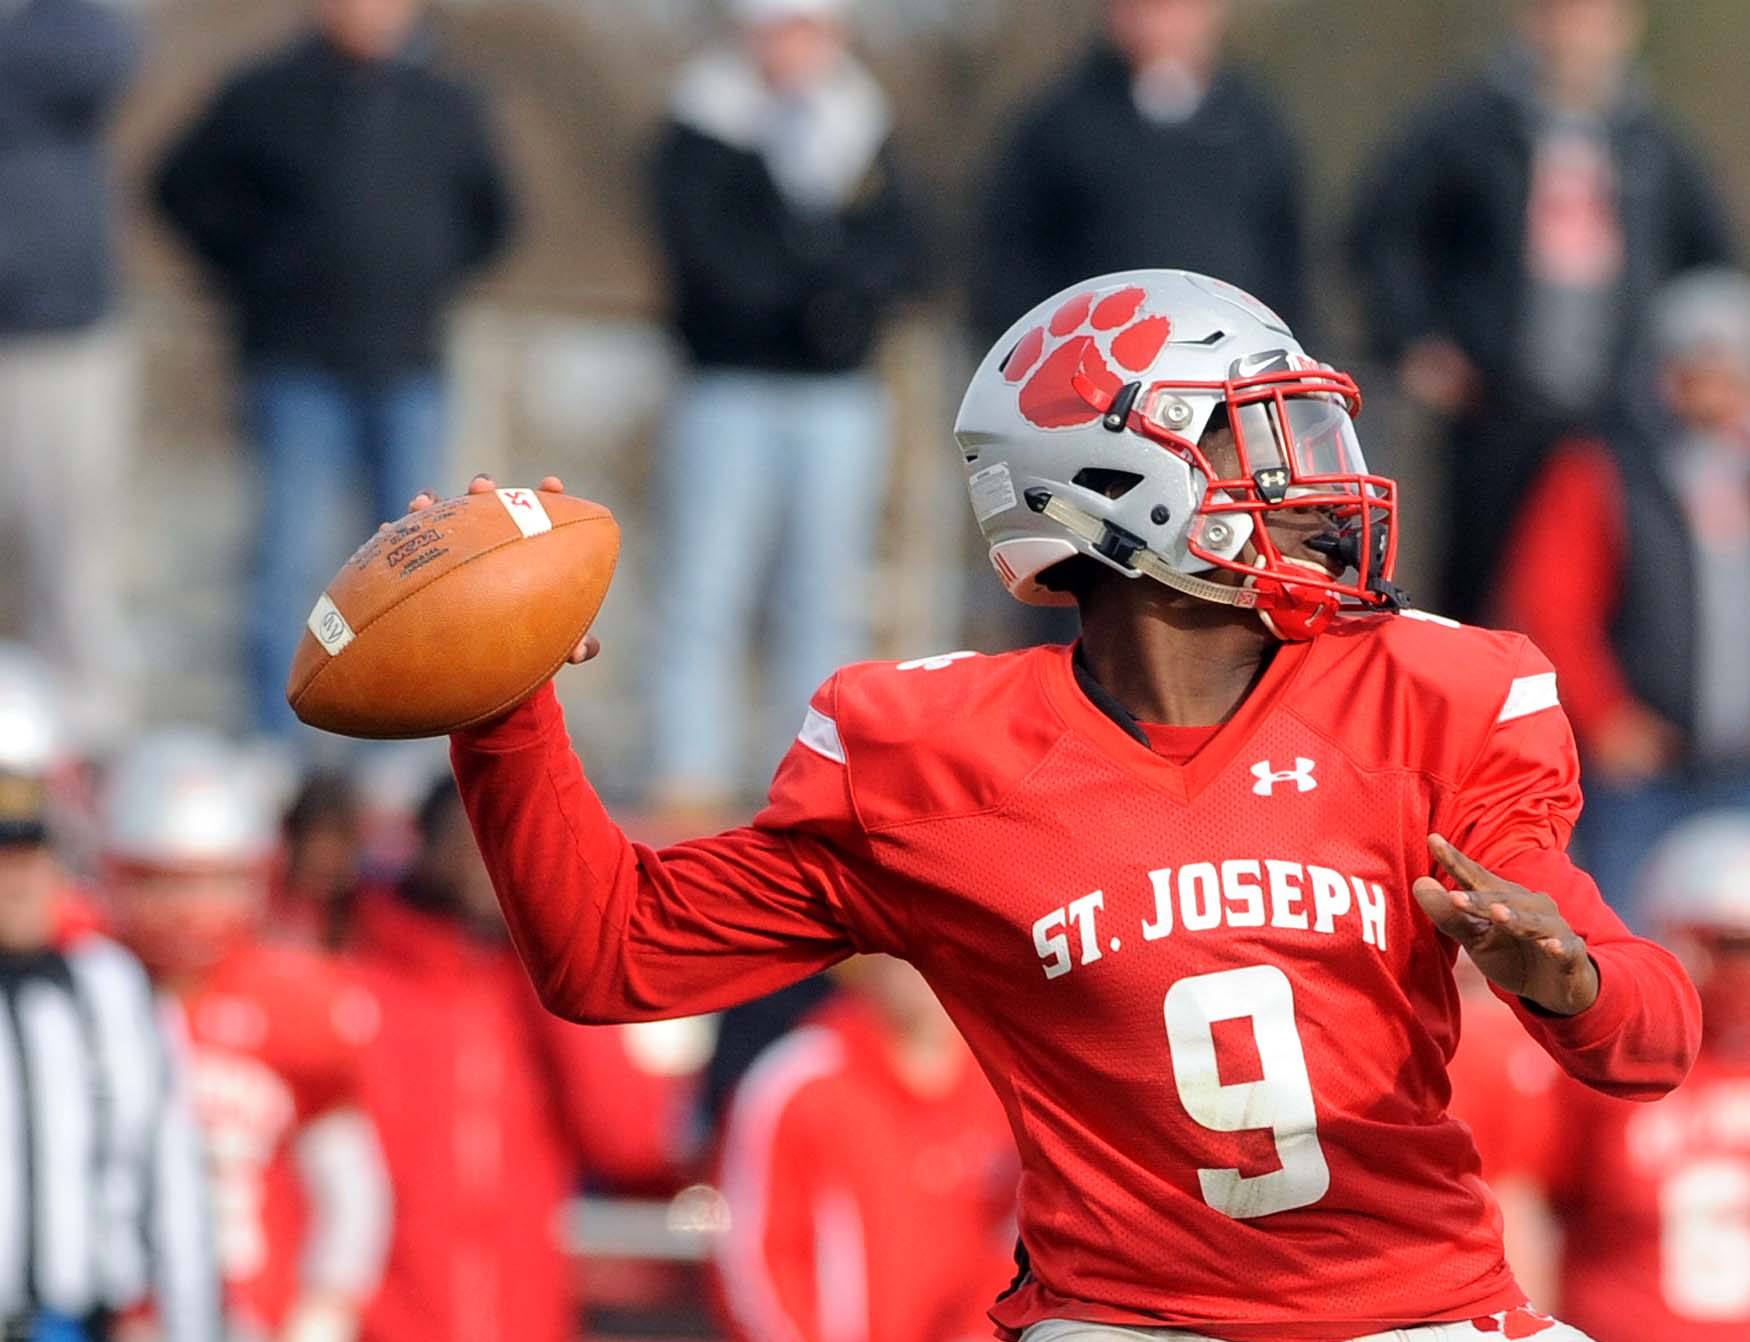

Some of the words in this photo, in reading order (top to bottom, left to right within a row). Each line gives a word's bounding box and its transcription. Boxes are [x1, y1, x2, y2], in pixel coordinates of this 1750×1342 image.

[1032, 889, 1121, 979] ST.
[1141, 858, 1387, 951] JOSEPH
[1163, 964, 1331, 1219] 9
